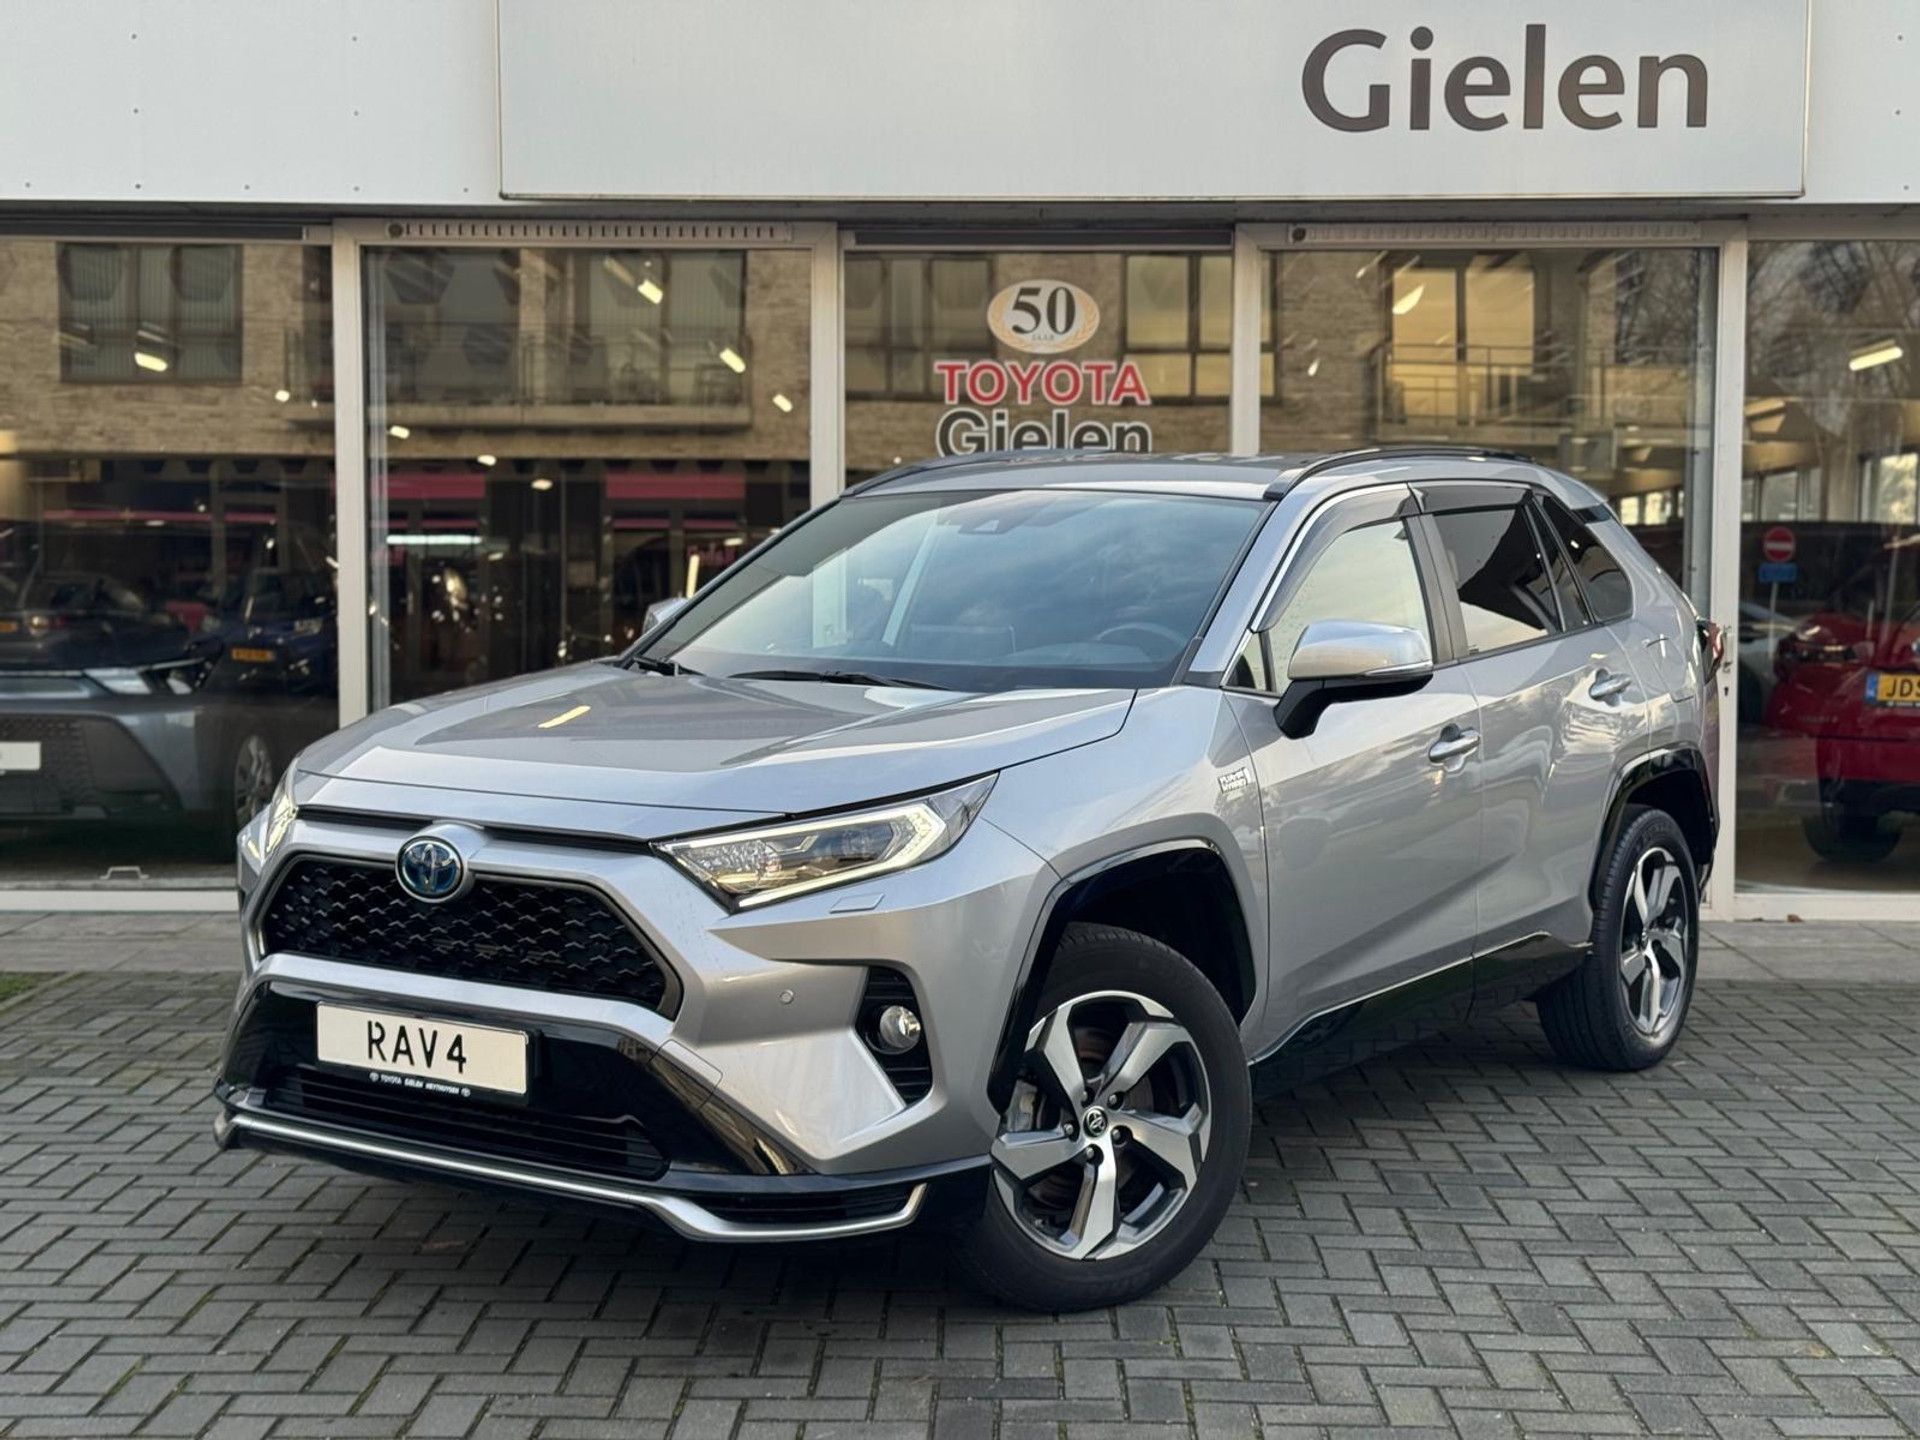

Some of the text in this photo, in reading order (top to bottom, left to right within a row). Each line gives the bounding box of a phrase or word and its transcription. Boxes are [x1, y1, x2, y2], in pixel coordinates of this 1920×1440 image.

[1302, 24, 1708, 132] Gielen
[1012, 286, 1076, 334] 50
[935, 361, 1149, 404] TOYOTA
[937, 408, 1151, 456] Gielen
[381, 1074, 402, 1085] TOYOTA
